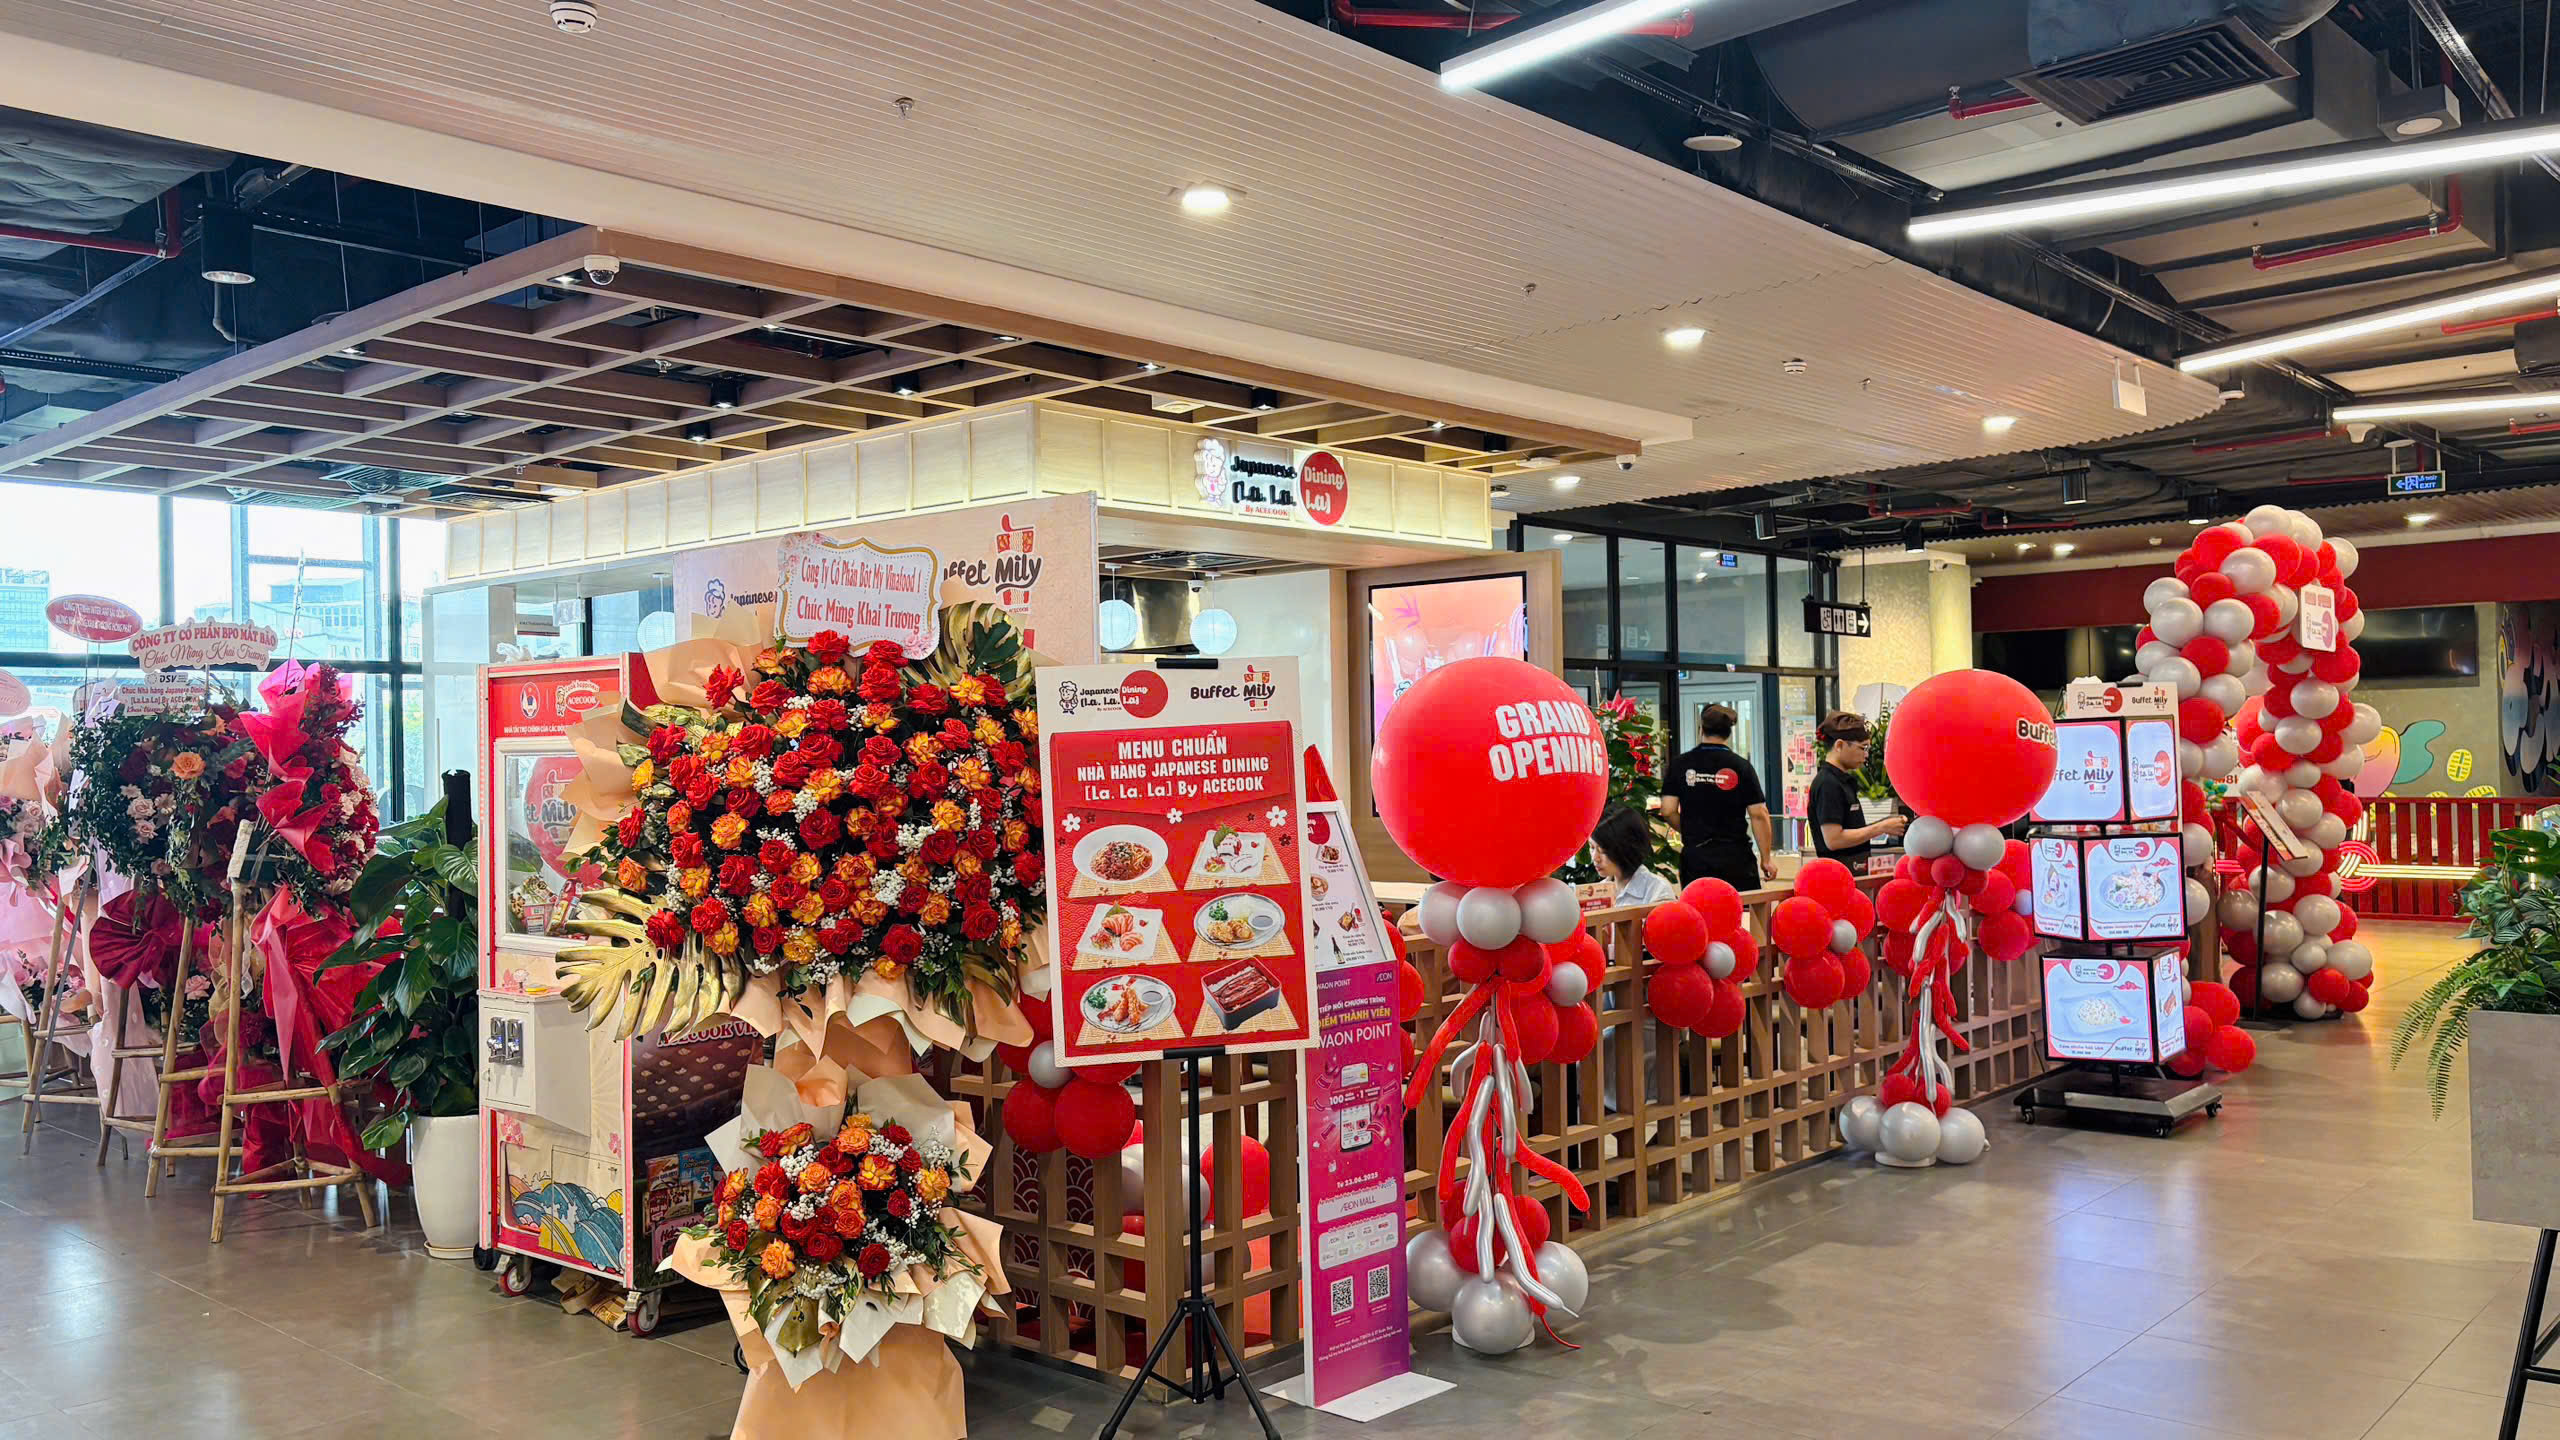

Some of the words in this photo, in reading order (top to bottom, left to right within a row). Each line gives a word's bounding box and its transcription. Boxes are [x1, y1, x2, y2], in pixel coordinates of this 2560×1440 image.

[1231, 456, 1297, 479] Japanese
[1304, 466, 1345, 490] Dining
[801, 557, 820, 589] Công
[822, 558, 829, 589] Ty
[885, 564, 916, 592] Vinafood
[995, 554, 1042, 593] Mily
[797, 595, 823, 621] Chúc
[825, 598, 855, 629] Mừng
[857, 601, 882, 627] Khai
[885, 604, 921, 635] Trương
[133, 634, 161, 651] CÔNG
[163, 630, 176, 643] TY
[222, 627, 239, 639] BPO
[144, 650, 168, 668] Chúc
[206, 641, 236, 659] Khai
[1080, 688, 1119, 696] Japanese
[1122, 686, 1148, 694] Dining
[1190, 685, 1240, 699] Buffet
[1243, 683, 1276, 702] Mily
[1496, 701, 1591, 739] GRAND
[1118, 740, 1165, 760] MENU
[1171, 730, 1227, 757] CHUẨN
[1077, 761, 1106, 782] NHÀ
[1110, 760, 1147, 780] HÀNG
[1151, 760, 1217, 777] JAPANESE
[1222, 757, 1269, 774] DINING
[1489, 736, 1604, 783] OPENING
[1084, 785, 1115, 801] [La.
[1119, 783, 1143, 799] La.
[1147, 780, 1172, 797] La]
[1178, 780, 1198, 797] By
[1203, 776, 1264, 794] ACECOOK
[2084, 769, 2114, 785] Mily
[1334, 978, 1350, 988] POINT
[1339, 1008, 1369, 1024] THÀNH
[1370, 1005, 1391, 1019] VIÊN
[1356, 1023, 1392, 1043] POINT
[1329, 1095, 1344, 1105] 100
[1360, 1195, 1377, 1207] MALL
